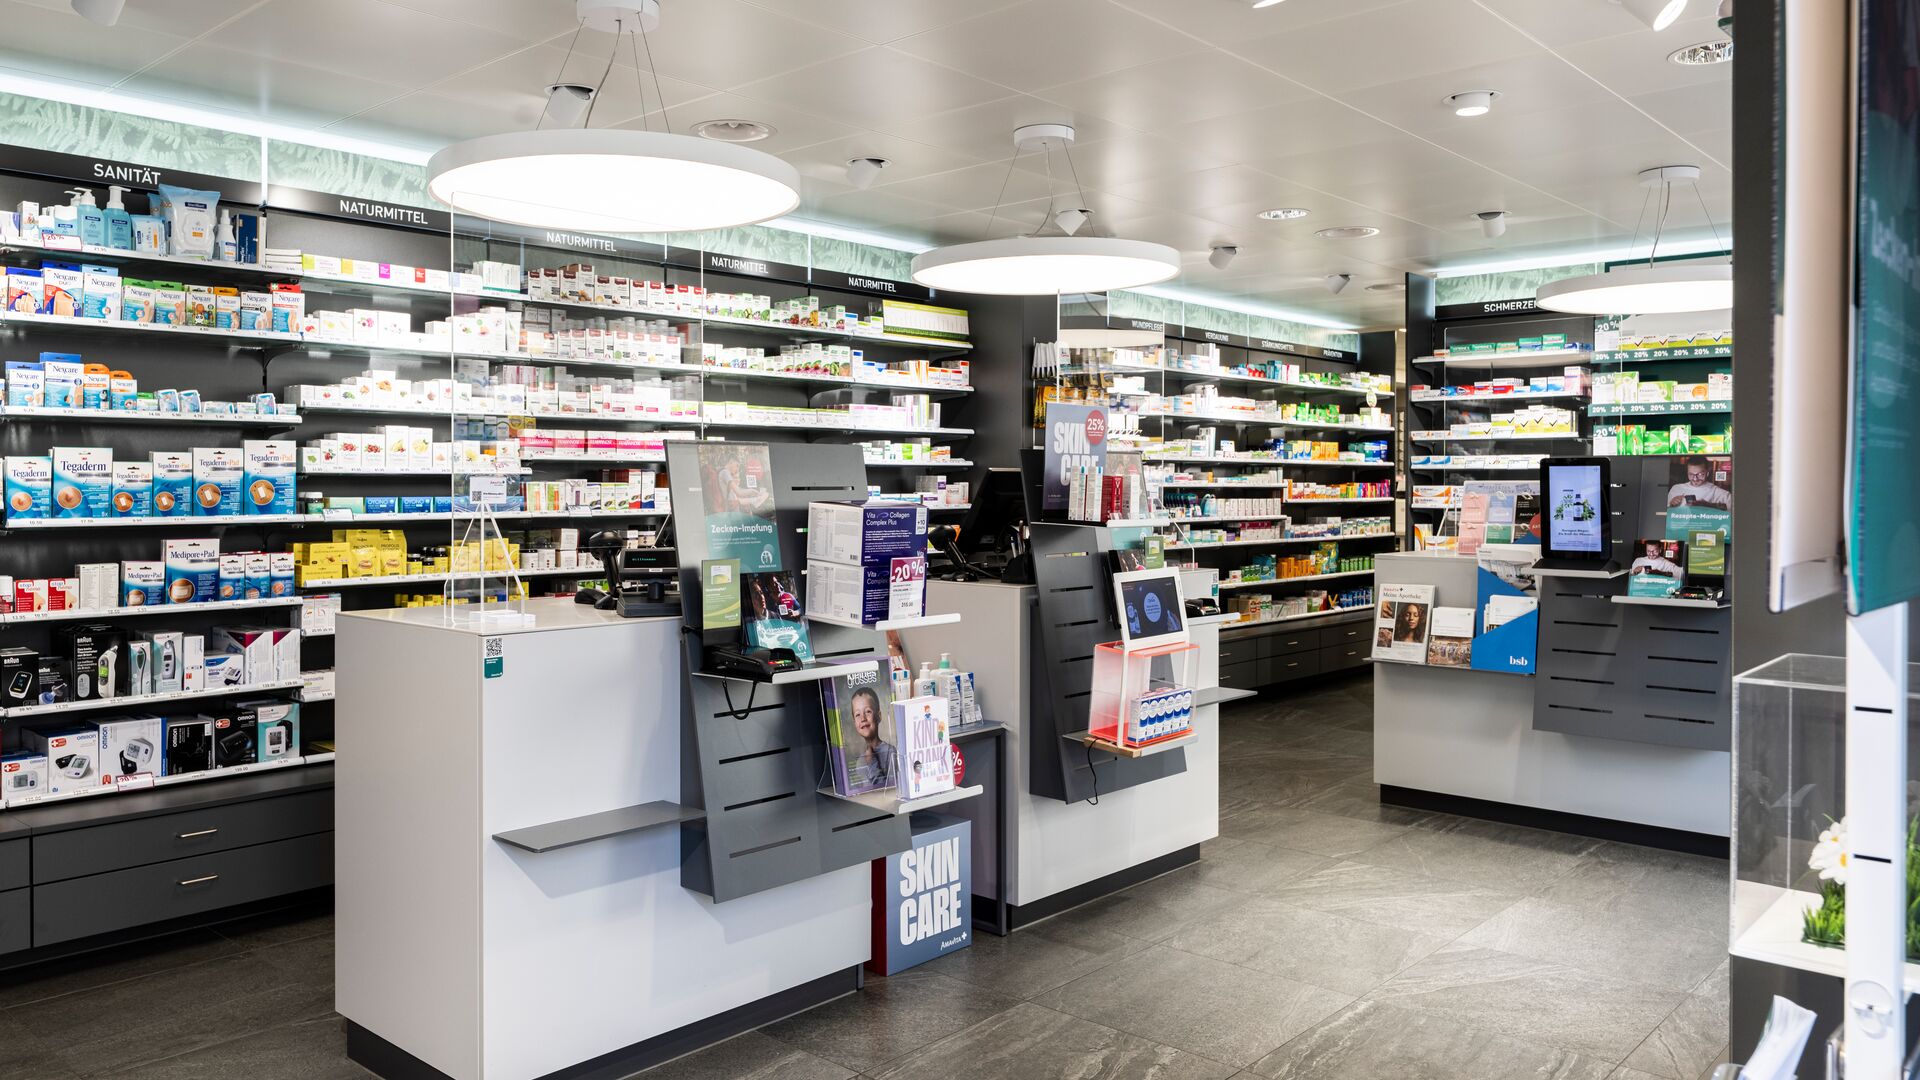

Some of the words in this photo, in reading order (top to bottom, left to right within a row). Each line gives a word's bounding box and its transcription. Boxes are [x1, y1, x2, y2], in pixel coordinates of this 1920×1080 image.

[93, 163, 161, 185] SANITÄT
[340, 200, 428, 225] NATURMITTEL
[546, 232, 617, 252] NATURMITTEL
[711, 256, 769, 275] NATURMITTEL
[53, 272, 78, 282] Nexcare
[16, 278, 38, 287] Nexcare
[91, 278, 117, 288] Nexcare
[848, 277, 897, 293] NATURMITTEL
[130, 288, 151, 297] Nexcare
[161, 292, 181, 300] Nexcare
[246, 295, 268, 303] Nexcare
[279, 295, 300, 303] Nexcare
[53, 365, 79, 374] Nexcare
[16, 372, 39, 381] Nexcare
[1087, 419, 1104, 431] 25%
[1054, 421, 1090, 455] SKIN
[250, 454, 279, 462] Tegaderm
[60, 460, 107, 474] Tegaderm
[12, 469, 48, 479] Tegaderm
[890, 511, 910, 520] Collagen
[1671, 512, 1730, 520] Rezepte-Manager
[711, 524, 773, 534] Zecken-Impfung
[170, 551, 200, 560] Medipore
[890, 563, 910, 583] -20
[911, 558, 924, 576] %
[1509, 655, 1528, 666] bsb
[900, 836, 960, 898] SKIN
[900, 882, 962, 946] CARE
